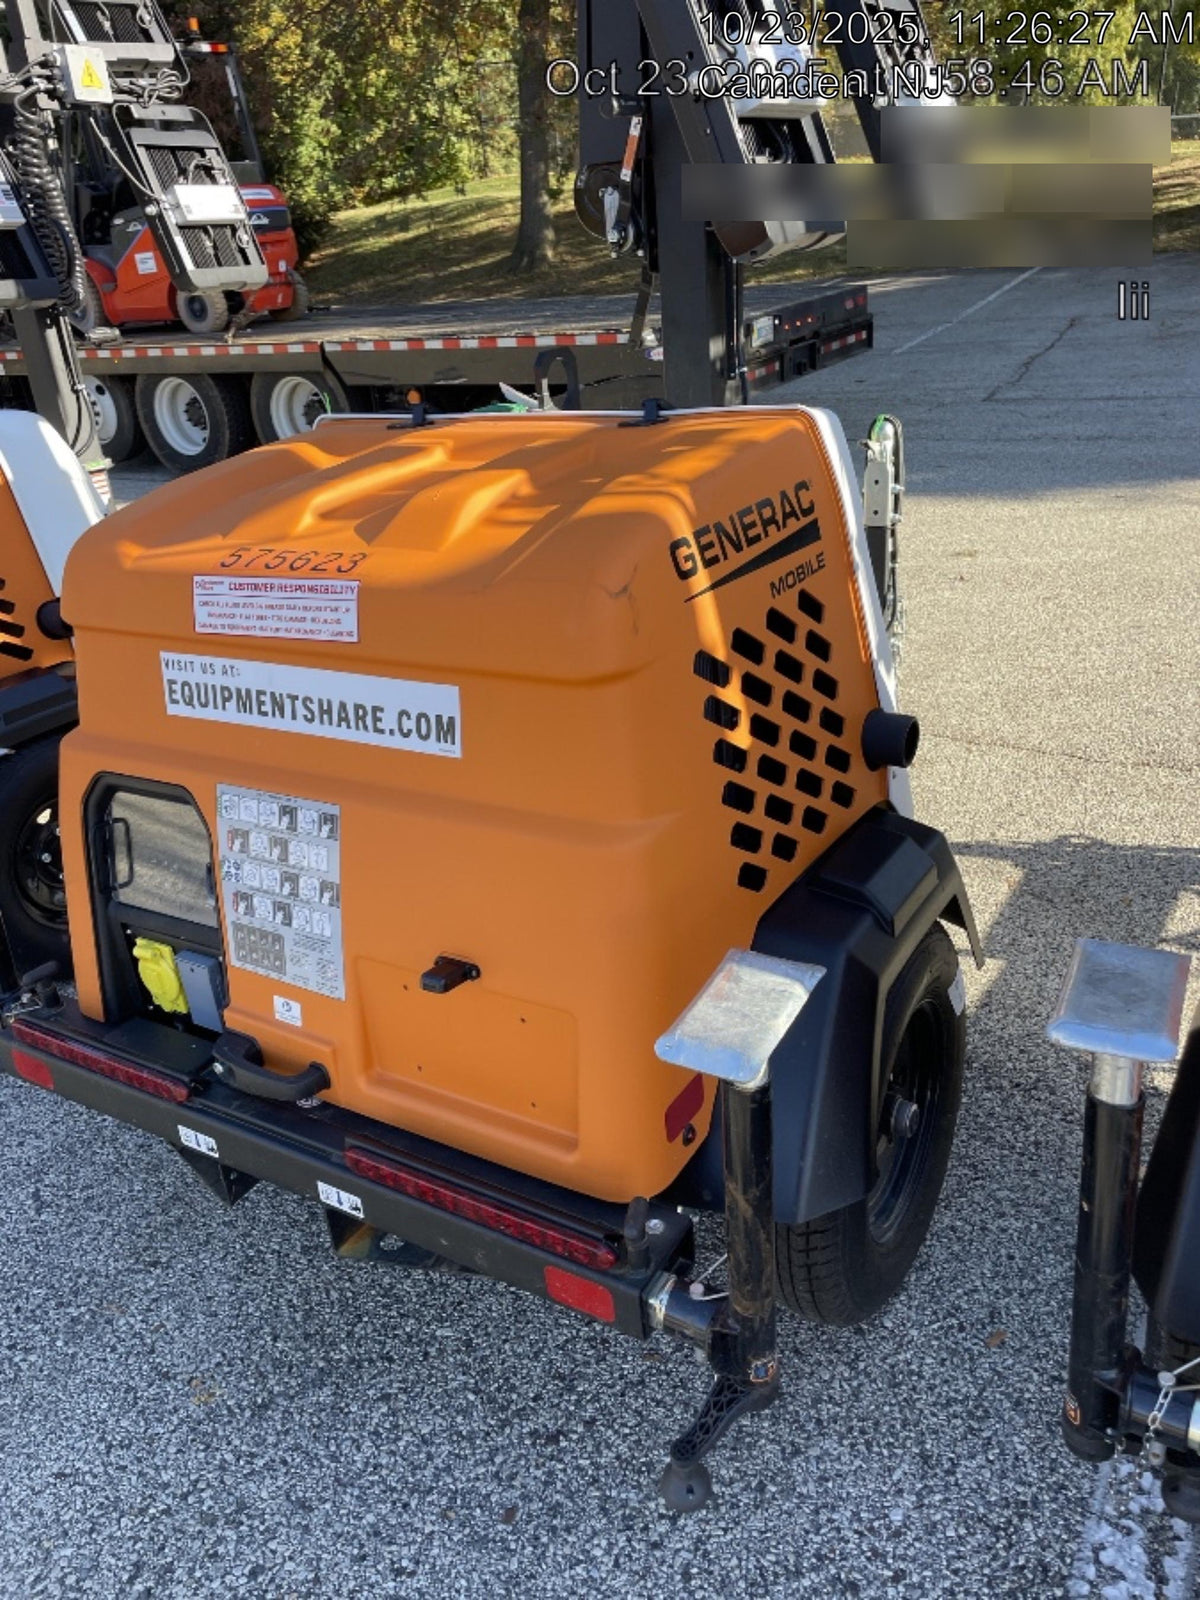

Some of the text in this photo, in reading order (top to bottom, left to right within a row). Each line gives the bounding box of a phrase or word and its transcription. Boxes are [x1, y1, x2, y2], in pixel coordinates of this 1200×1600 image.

[669, 479, 816, 581] GENERAC
[219, 546, 368, 573] 575623
[769, 551, 827, 599] MOBILE
[228, 582, 276, 594] CUSTOMER
[162, 656, 241, 678] VISIT US AT:
[166, 678, 457, 746] EQUIPMENTSHARE.COM
